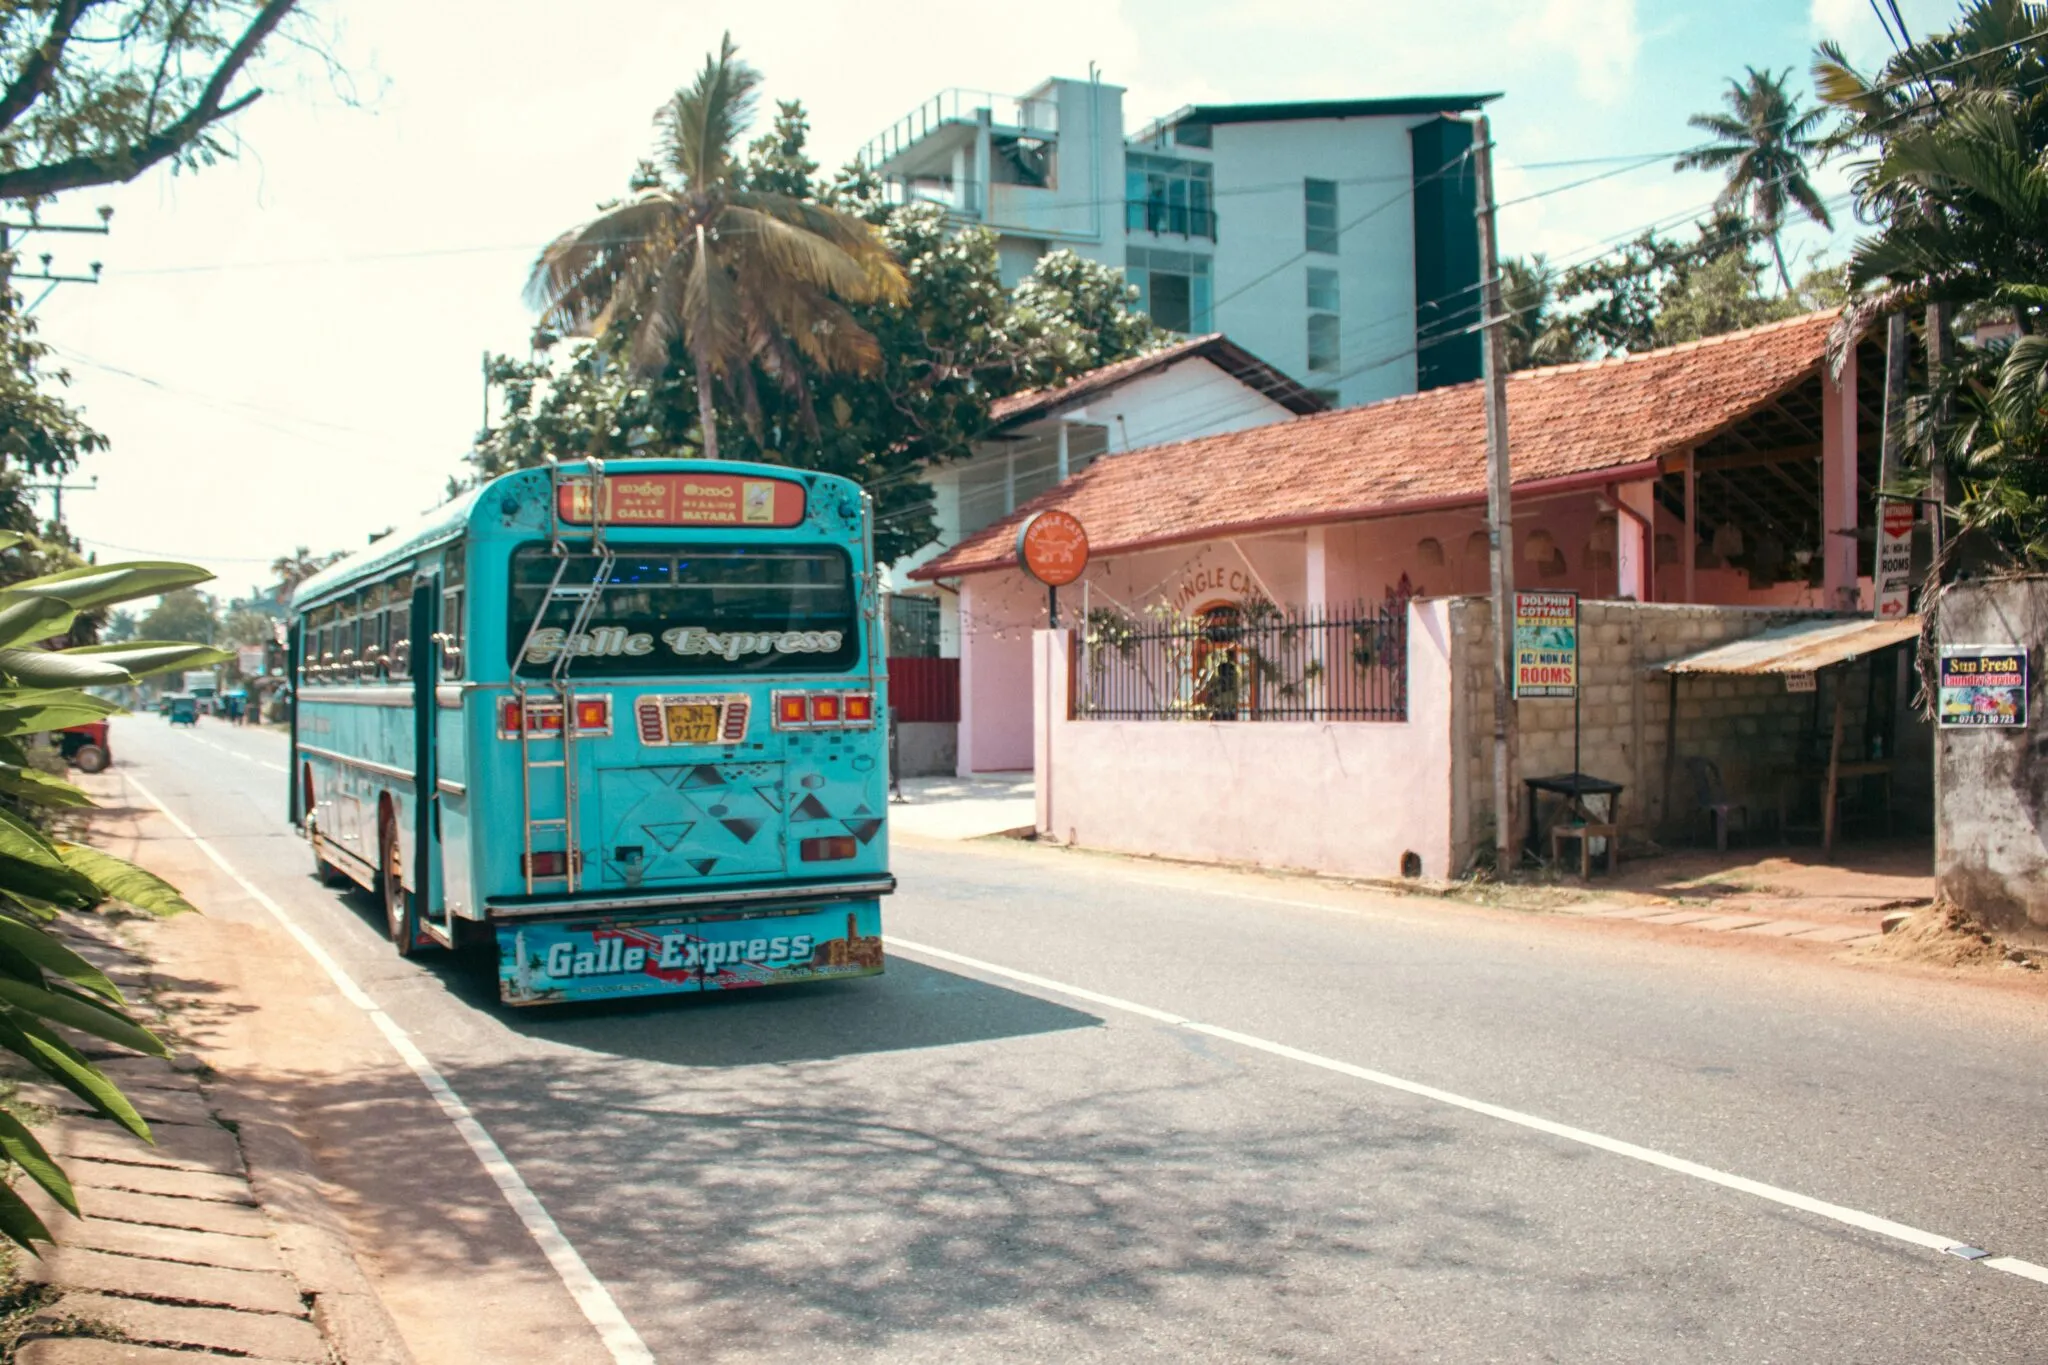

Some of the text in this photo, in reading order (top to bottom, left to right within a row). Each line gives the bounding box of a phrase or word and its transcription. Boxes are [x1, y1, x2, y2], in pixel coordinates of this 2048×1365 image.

[617, 509, 664, 518] GALLE
[683, 511, 736, 520] MATARA
[1882, 559, 1909, 572] ROOMS
[1172, 567, 1225, 613] UNGLE
[1522, 596, 1570, 606] DOLPHIN
[1521, 607, 1572, 617] COTTAGE
[661, 626, 842, 661] Express
[1540, 653, 1558, 665] NON
[1561, 653, 1573, 665] AC
[1950, 657, 2018, 673] Sun Fresh
[1520, 667, 1572, 684] ROOMS
[546, 934, 813, 978] Galle Express
